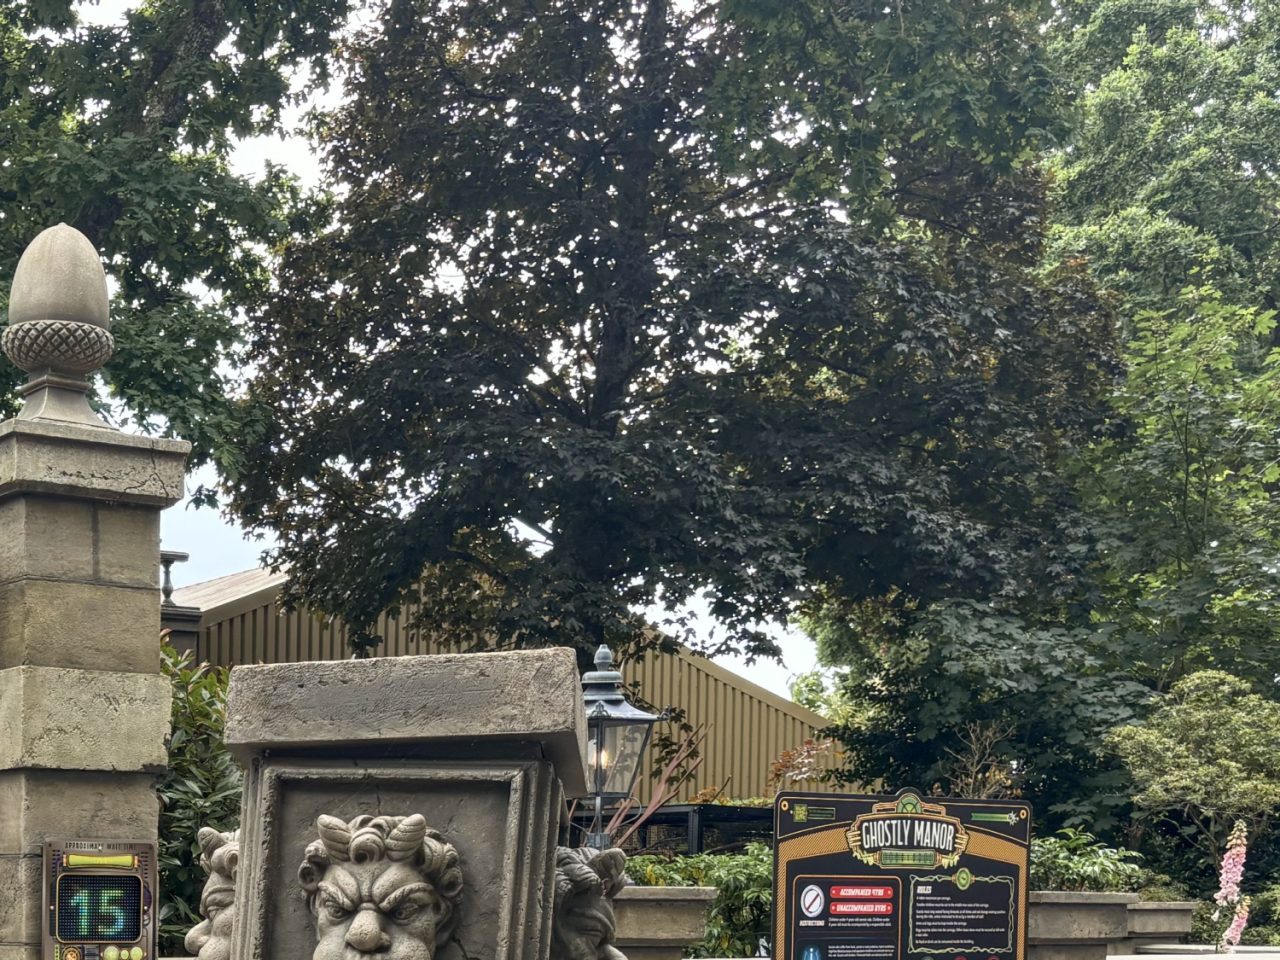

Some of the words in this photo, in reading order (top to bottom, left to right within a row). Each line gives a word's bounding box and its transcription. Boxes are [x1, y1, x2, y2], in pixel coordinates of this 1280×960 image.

[862, 820, 910, 848] GHOSTLY
[914, 820, 955, 850] MANOR
[70, 889, 124, 935] 15
